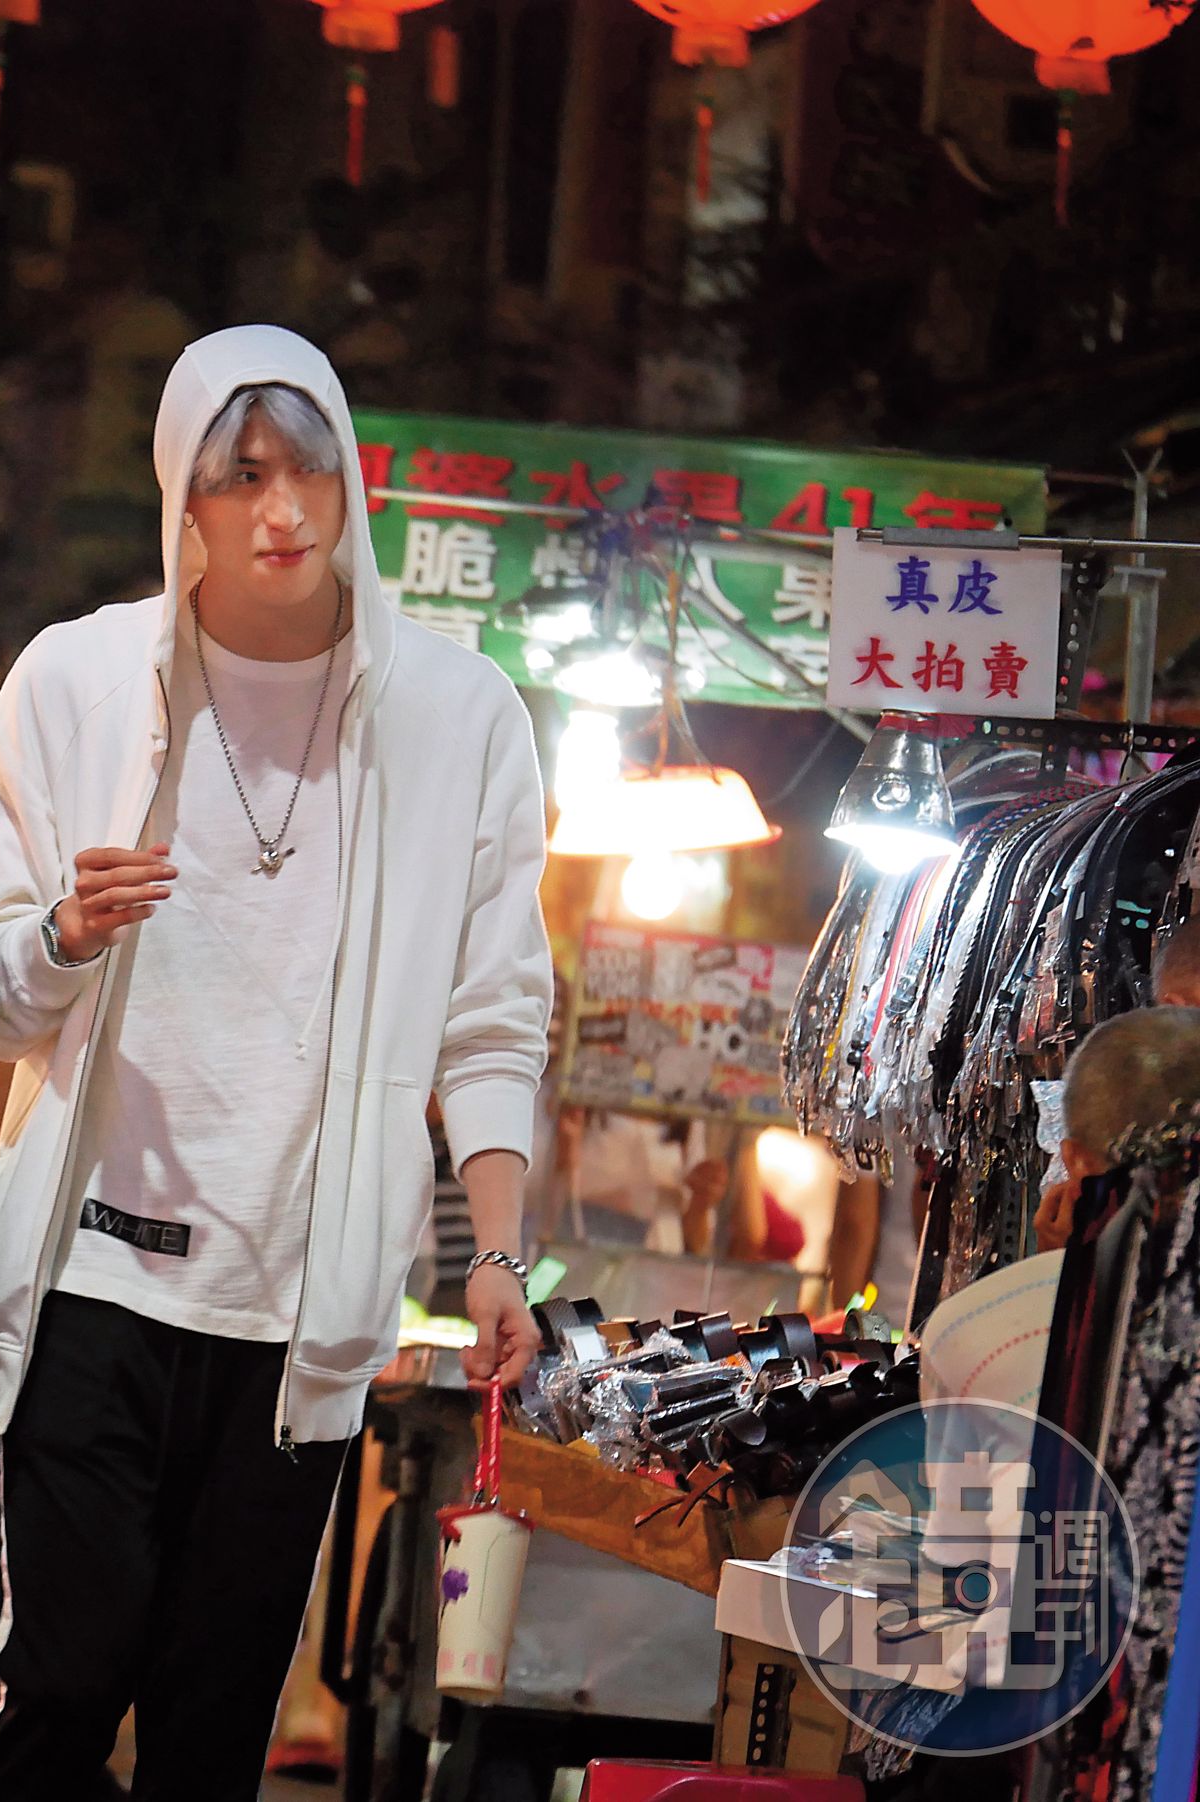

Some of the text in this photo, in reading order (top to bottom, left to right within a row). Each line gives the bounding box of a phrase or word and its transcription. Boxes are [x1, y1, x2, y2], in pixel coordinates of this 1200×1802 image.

[886, 555, 1003, 616] 真皮
[850, 636, 1029, 700] 大拍賣
